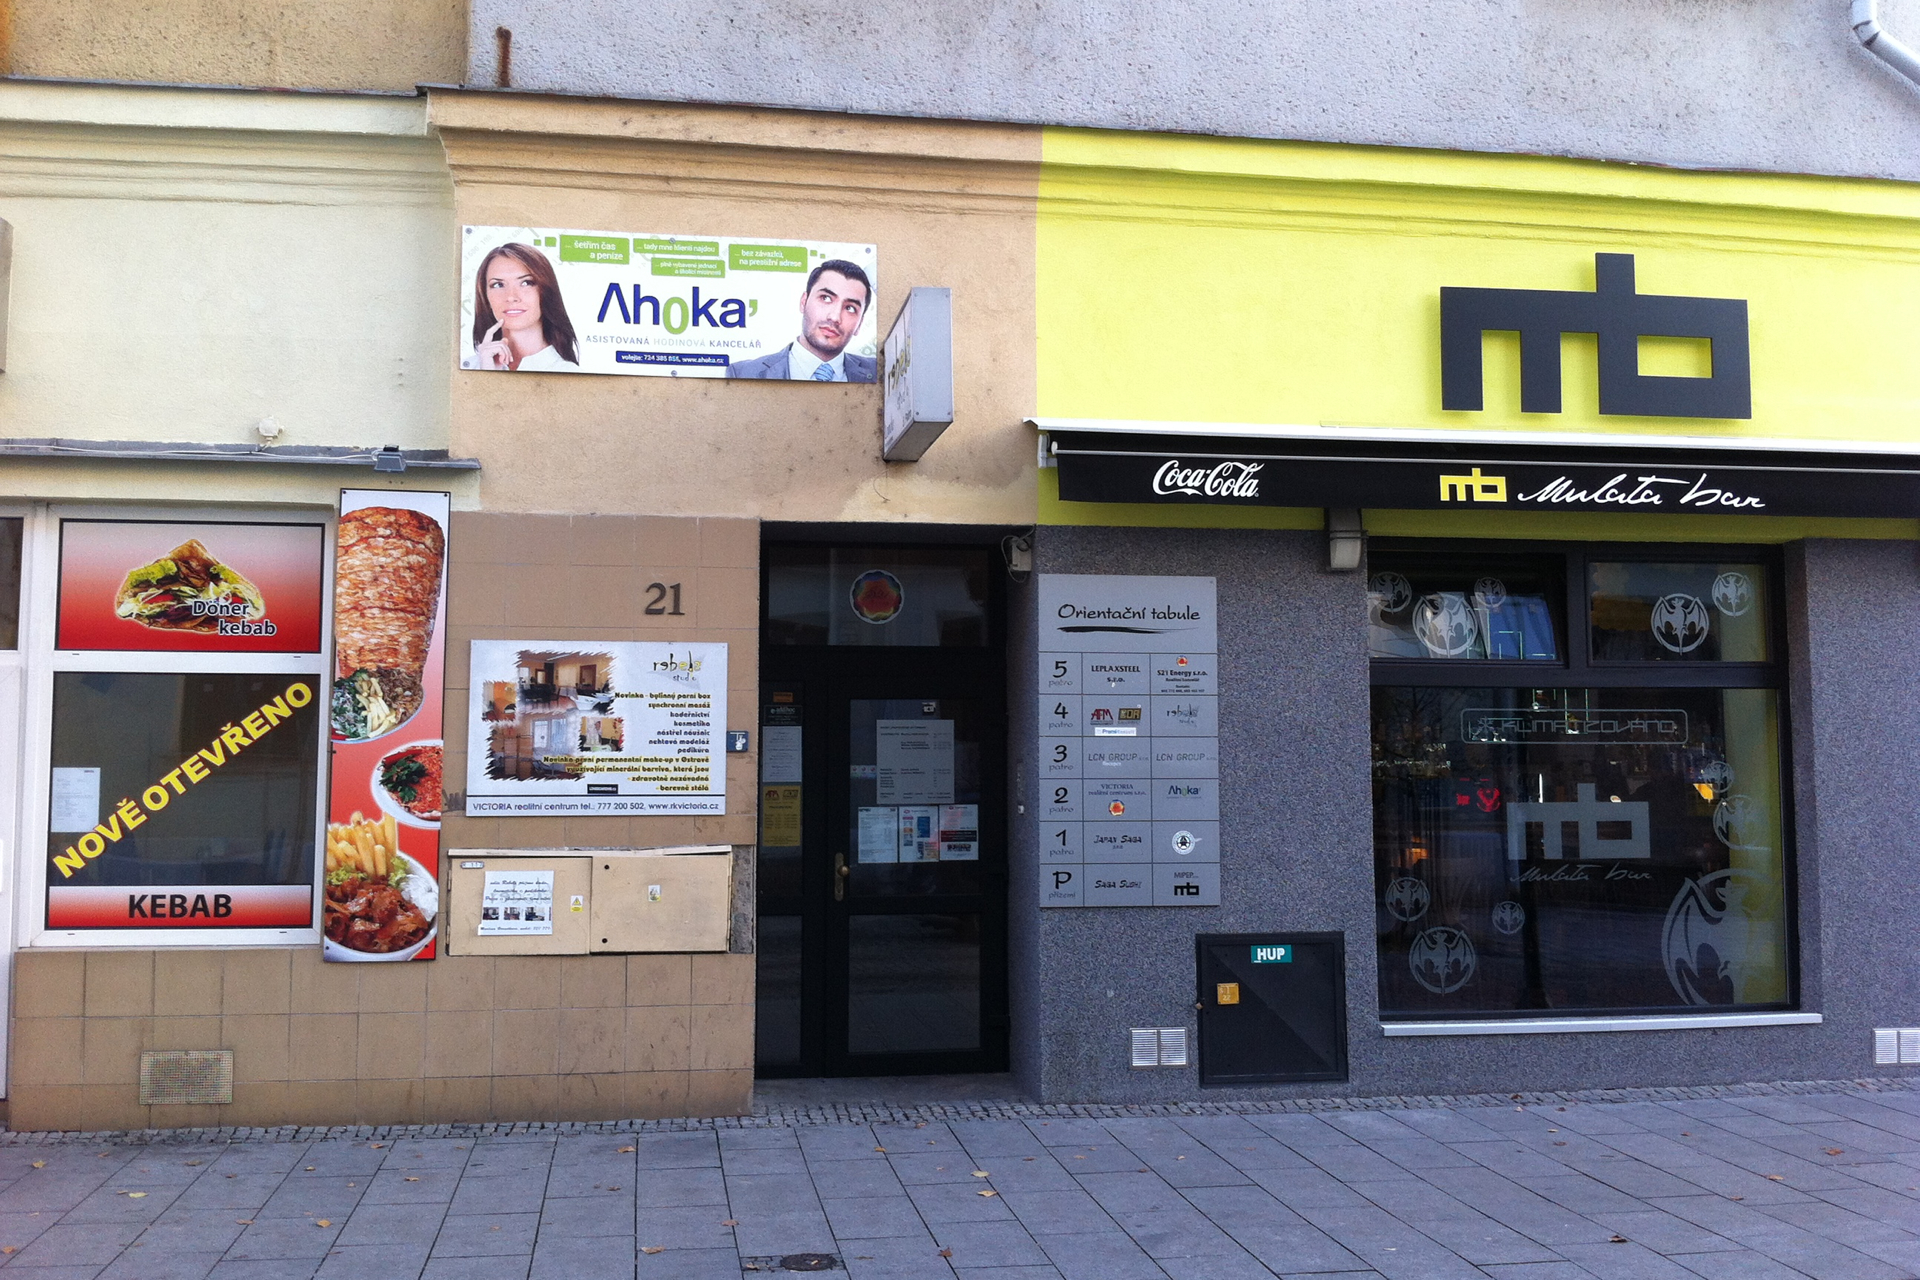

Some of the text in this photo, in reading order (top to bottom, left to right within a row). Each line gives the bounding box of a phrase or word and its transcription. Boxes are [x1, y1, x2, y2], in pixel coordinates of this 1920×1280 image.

[574, 240, 599, 250] šetřím
[601, 241, 616, 250] čas
[644, 243, 658, 251] tady
[694, 245, 715, 253] najdou
[597, 251, 623, 260] peníze
[585, 335, 762, 349] ASISTOVANÁ HODINOVÁ KANCELÁŘ
[1440, 252, 1752, 419] mb
[1440, 467, 1766, 508] mb Mulata bar
[644, 582, 685, 615] 21
[192, 599, 249, 616] Döner
[1058, 604, 1200, 620] Orientační tabule
[218, 619, 276, 636] kebab
[1053, 660, 1067, 678] 5
[1091, 665, 1141, 673] LEPLAXSTEEL
[1048, 680, 1073, 688] patro
[650, 692, 675, 700] bylinný
[677, 692, 696, 700] parní
[648, 701, 710, 709] synchronní masáž
[1054, 702, 1068, 719] 4
[1049, 722, 1073, 730] patro
[595, 756, 642, 764] permanentní
[643, 756, 674, 764] make-up
[1053, 745, 1067, 763] 3
[1088, 753, 1104, 762] LCN
[1108, 753, 1138, 761] GROUP
[1156, 753, 1173, 761] LCN
[1177, 753, 1205, 761] GROUP
[566, 765, 605, 773] využívající
[1049, 764, 1073, 772] patro
[52, 797, 148, 879] NOVĚ
[142, 682, 312, 812] OTEVŘENO
[1054, 787, 1068, 804] 2
[514, 802, 543, 810] realitní
[597, 802, 611, 810] 777
[613, 802, 628, 810] 200
[648, 802, 719, 810] www.rkvictoria.cz
[1049, 806, 1074, 815] patro
[1506, 783, 1651, 860] mb
[1055, 829, 1067, 847] 1
[1049, 849, 1074, 857] patro
[1509, 862, 1652, 882] Mulata bar
[1052, 870, 1072, 890] P
[1174, 882, 1200, 896] mb
[1048, 892, 1076, 901] přízemí
[128, 894, 232, 918] KEBAB
[1257, 948, 1285, 961] HUP
